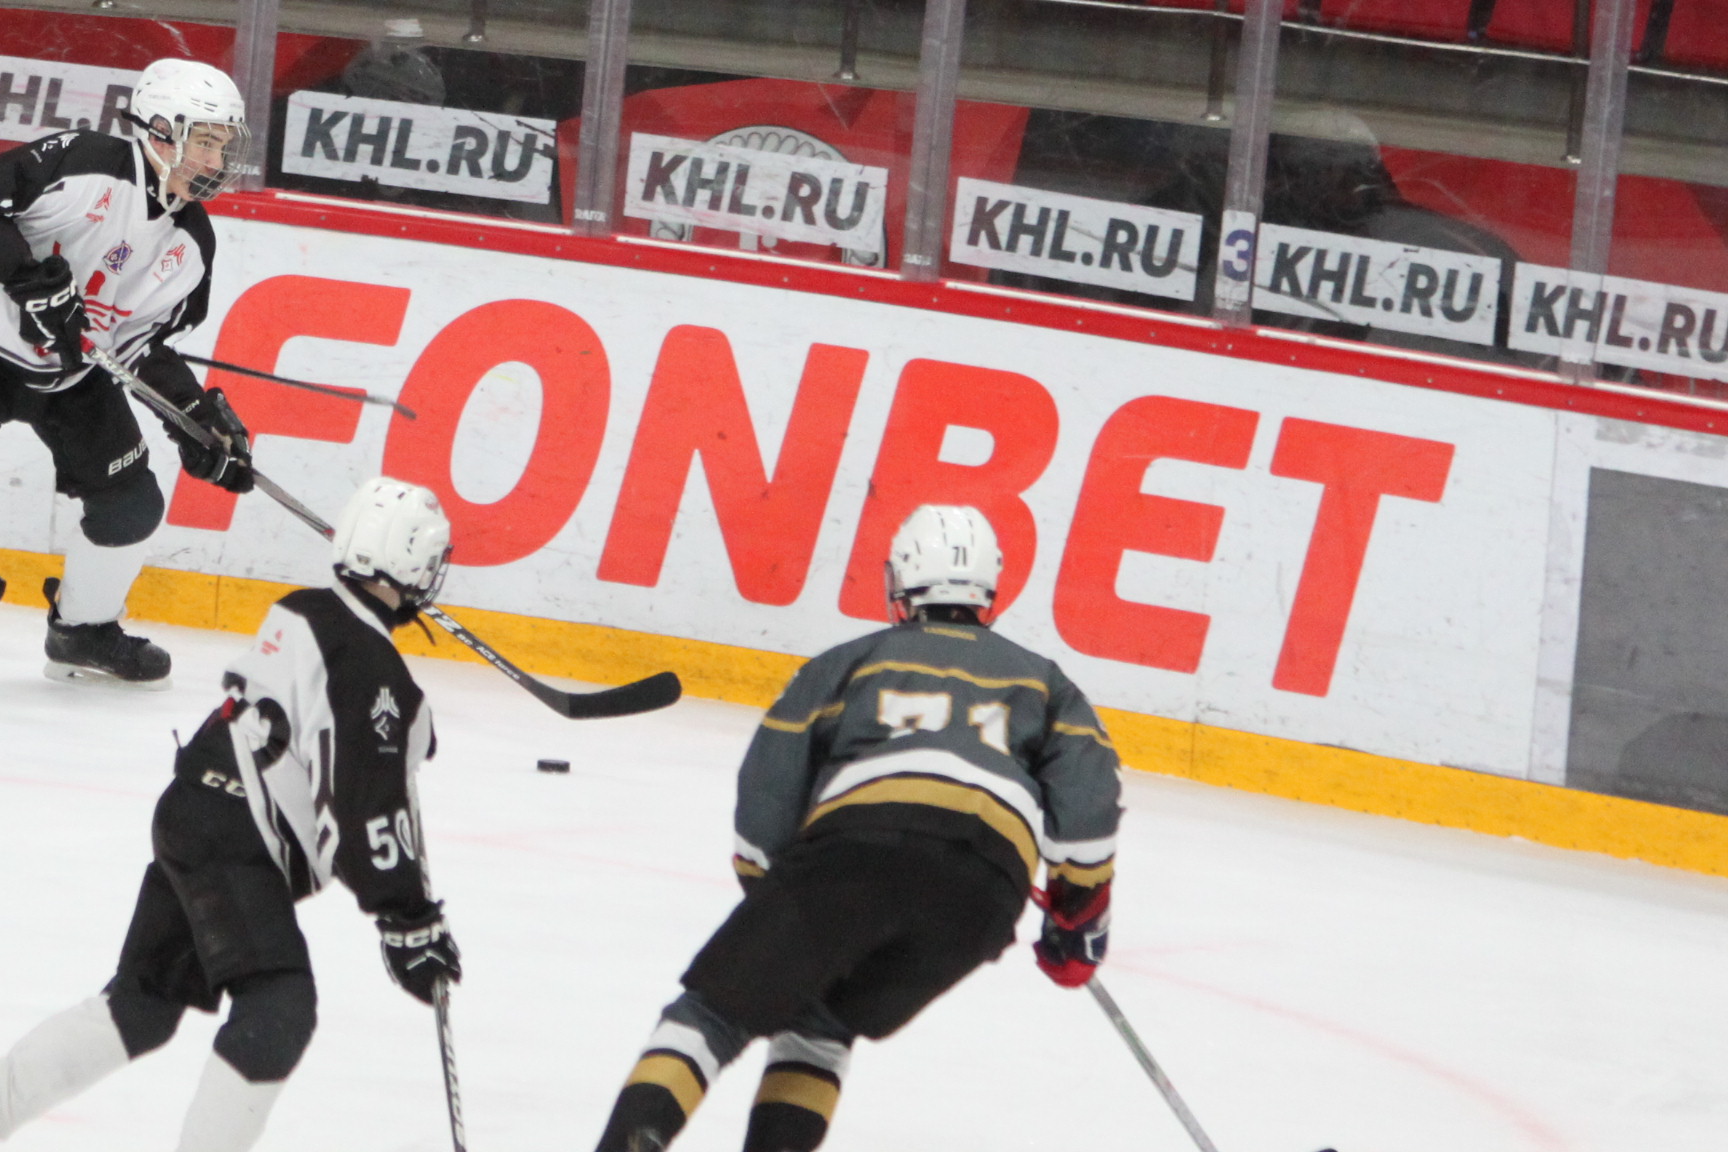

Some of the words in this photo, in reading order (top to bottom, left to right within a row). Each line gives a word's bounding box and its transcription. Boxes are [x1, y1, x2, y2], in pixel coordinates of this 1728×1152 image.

[301, 107, 538, 183] KHL.RU
[641, 152, 870, 231] KHL.RU
[966, 196, 1184, 278] KHL.RU
[1222, 229, 1255, 282] 3
[1271, 241, 1483, 324] KHL.RU
[165, 273, 1456, 698] FONBET
